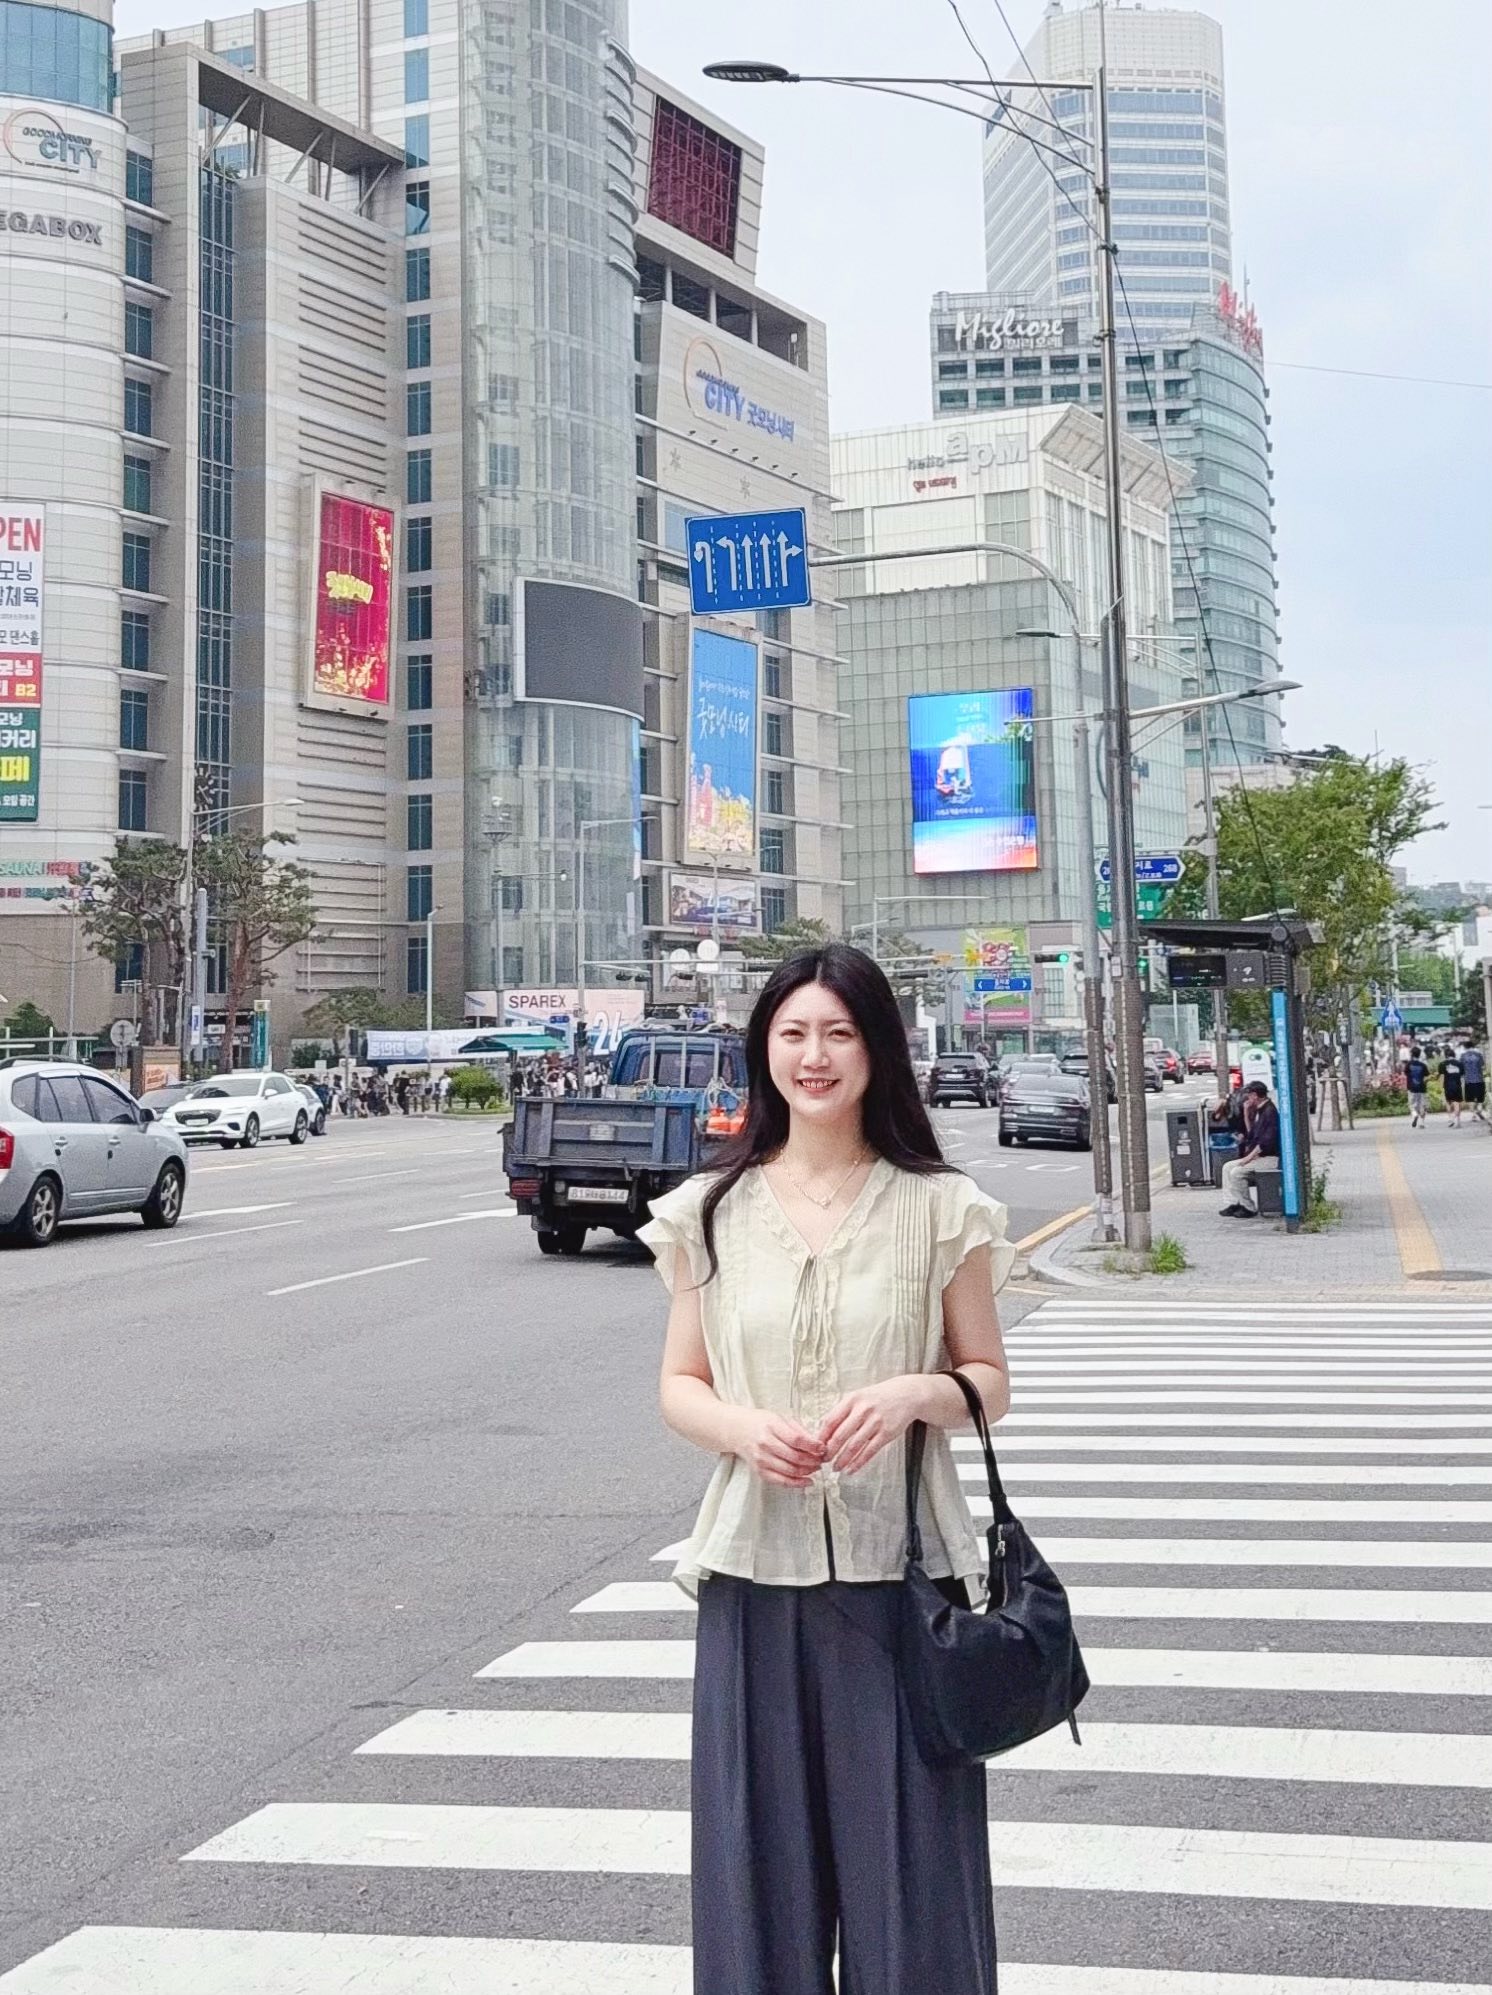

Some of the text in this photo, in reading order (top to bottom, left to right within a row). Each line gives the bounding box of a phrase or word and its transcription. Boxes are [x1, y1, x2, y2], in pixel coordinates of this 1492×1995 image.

[39, 138, 101, 169] CITY
[955, 307, 1064, 350] Migliore
[705, 381, 745, 421] CITY
[0, 585, 39, 607] 체육
[15, 683, 37, 697] B2
[0, 729, 36, 749] 커리
[508, 995, 567, 1009] SPAREX
